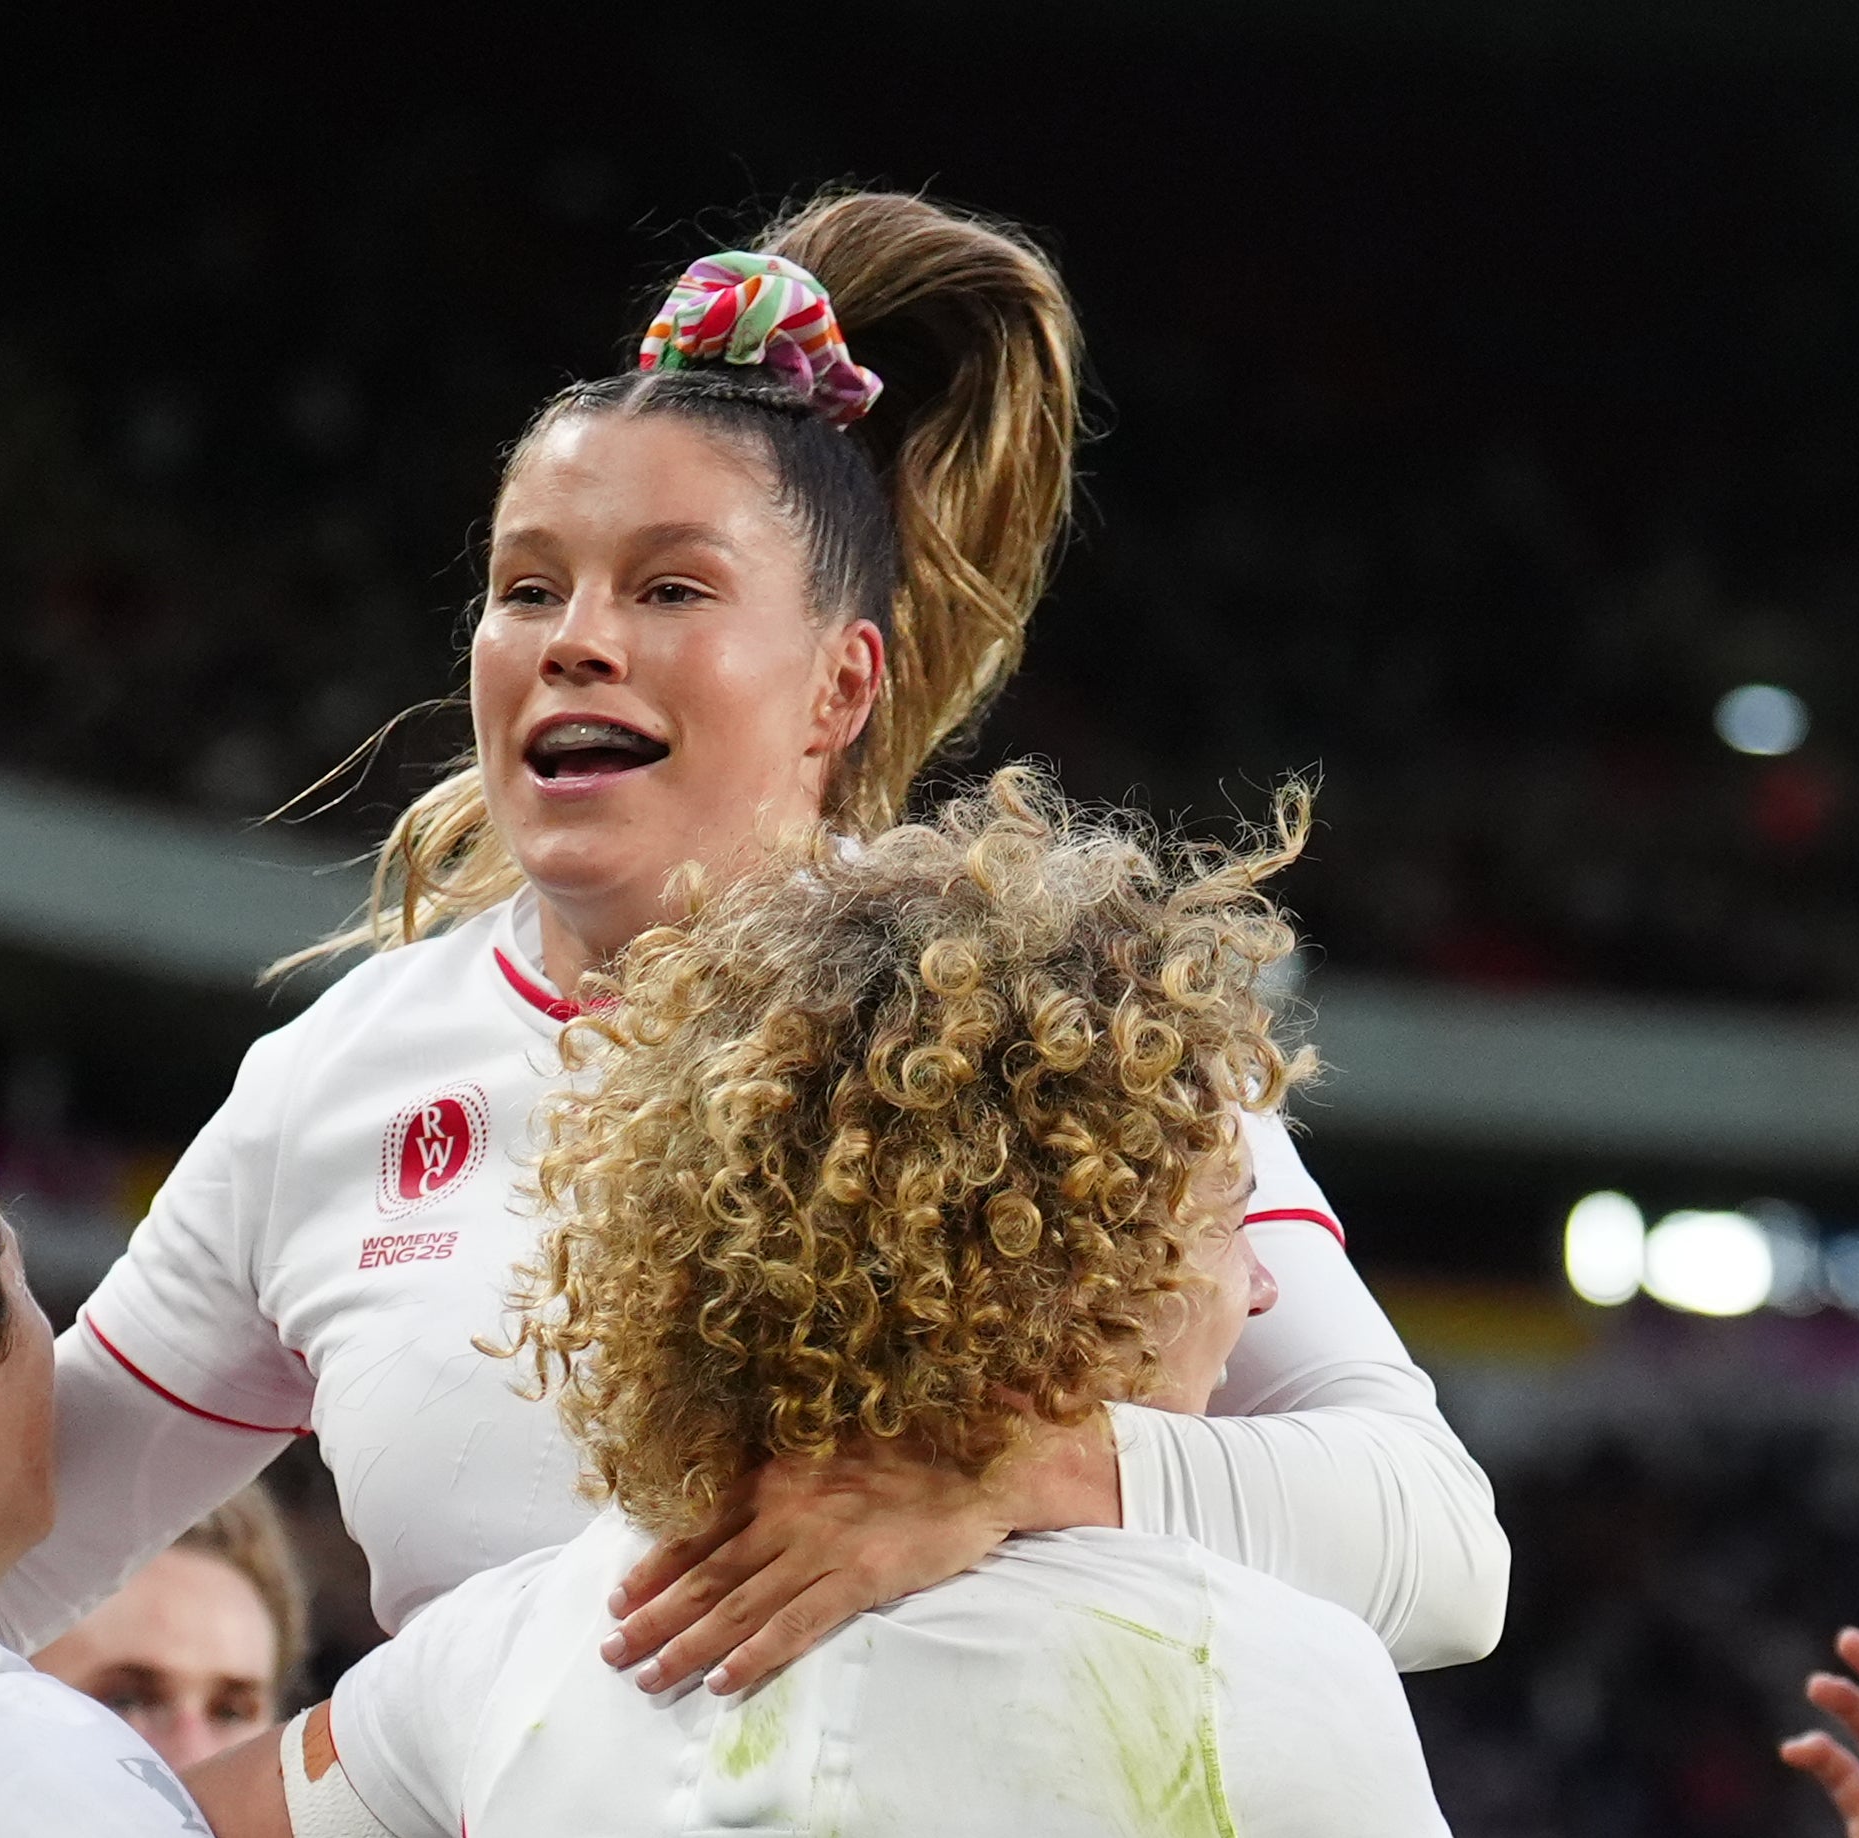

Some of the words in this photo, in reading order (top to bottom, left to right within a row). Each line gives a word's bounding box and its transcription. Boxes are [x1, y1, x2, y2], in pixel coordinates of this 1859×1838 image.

[415, 1106, 455, 1196] RWC
[362, 1231, 459, 1250] WOMEN'S
[358, 1244, 454, 1270] ENG25
